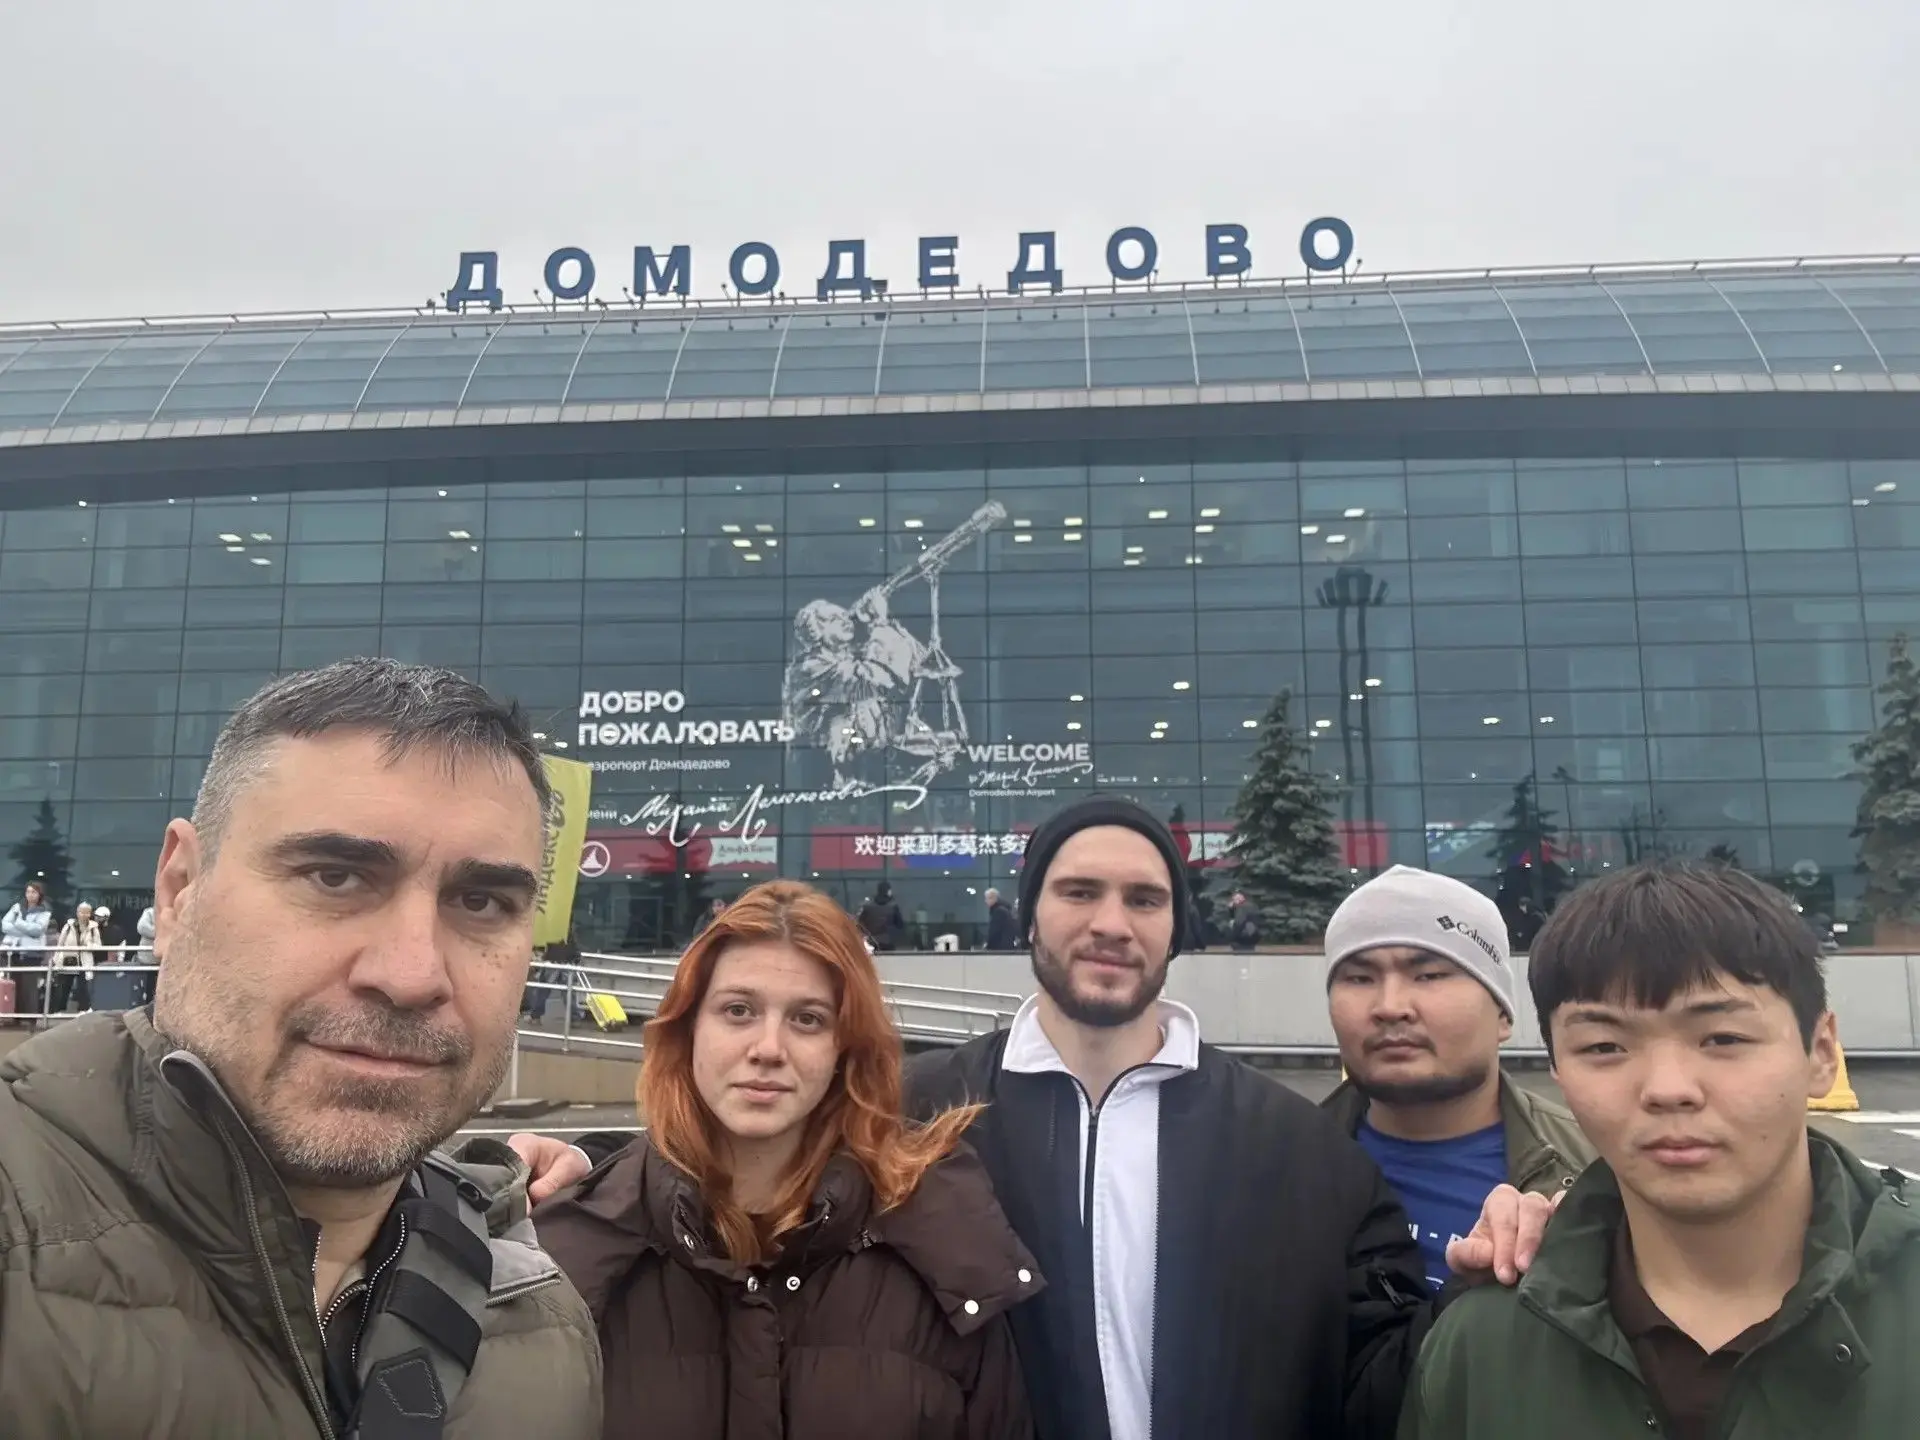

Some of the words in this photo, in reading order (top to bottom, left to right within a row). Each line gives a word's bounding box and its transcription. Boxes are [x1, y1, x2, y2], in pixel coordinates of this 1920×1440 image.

[447, 216, 1353, 312] ДОМОДЕДОВО
[579, 690, 685, 718] ДОБРО
[578, 719, 796, 746] ПОЖАЛОВАТЬ
[649, 757, 731, 772] Домодедово
[968, 743, 1090, 762] WELCOME
